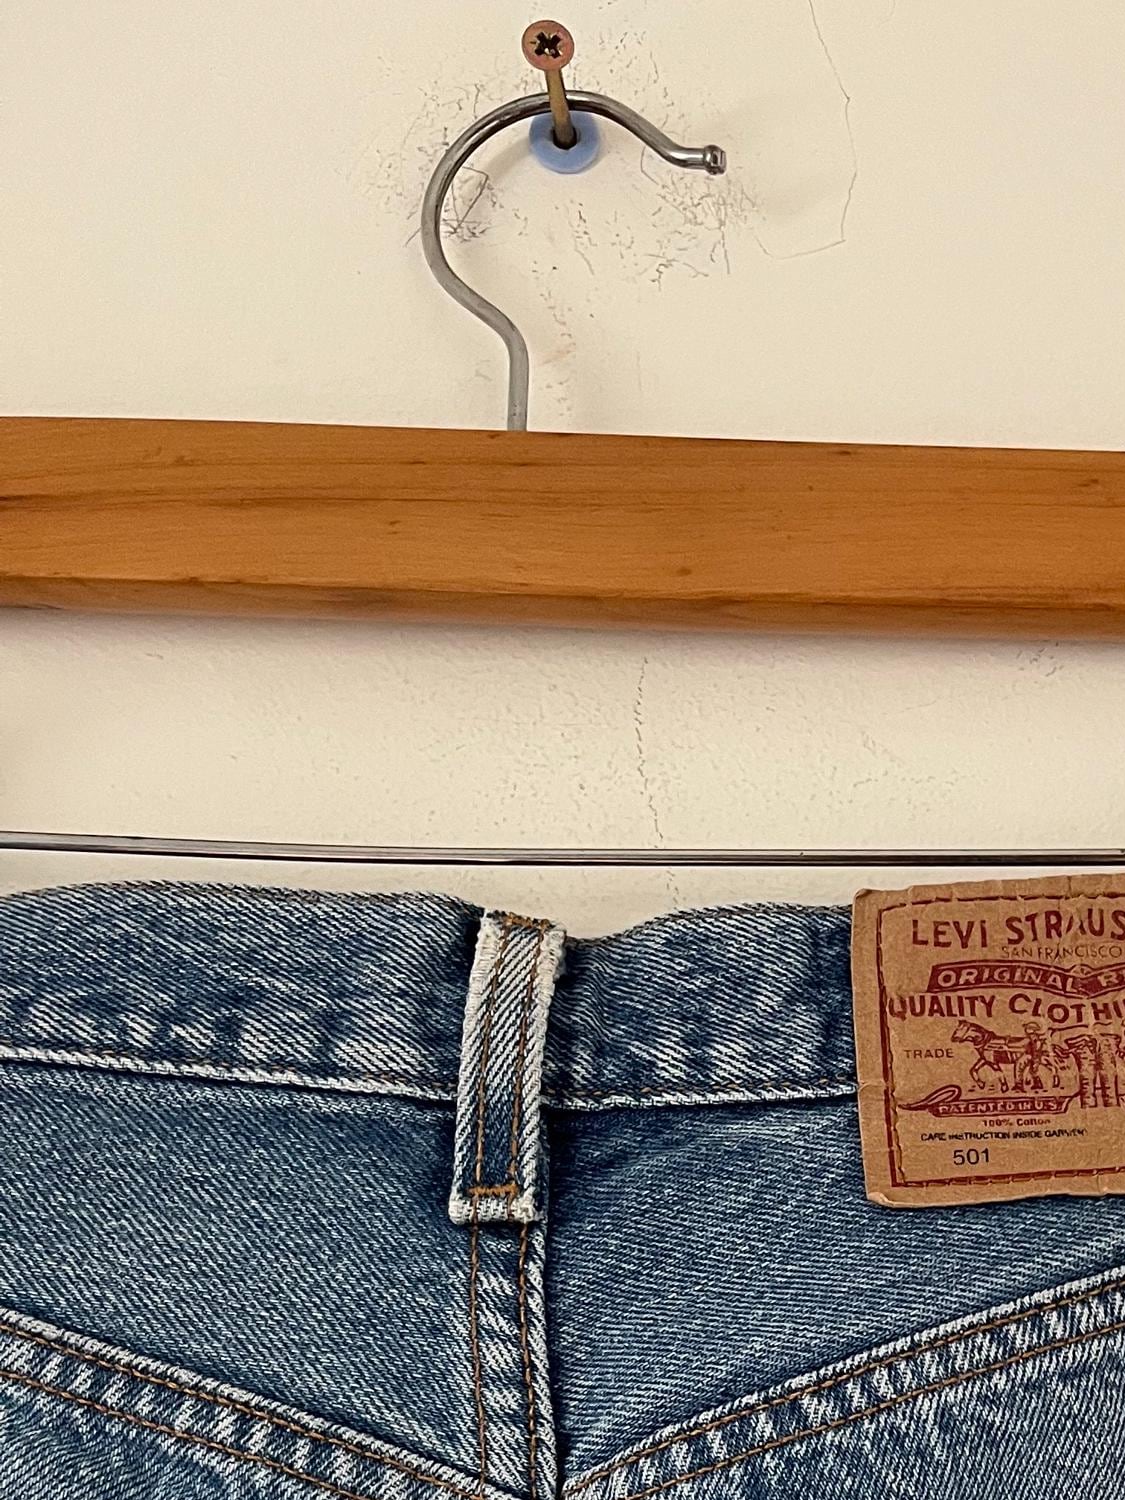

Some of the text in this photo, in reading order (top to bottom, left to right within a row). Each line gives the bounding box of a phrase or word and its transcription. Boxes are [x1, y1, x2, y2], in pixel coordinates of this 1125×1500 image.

[912, 919, 988, 949] LEVI
[1001, 945, 1033, 959] SAN
[1037, 944, 1123, 961] FRANCISCO
[937, 966, 1078, 993] ORIGINAL
[888, 994, 996, 1021] QUALITY
[904, 1048, 954, 1060] TRADE
[938, 1102, 1015, 1114] PATENTED
[920, 1132, 947, 1142] CARE
[952, 1147, 990, 1166] 501
